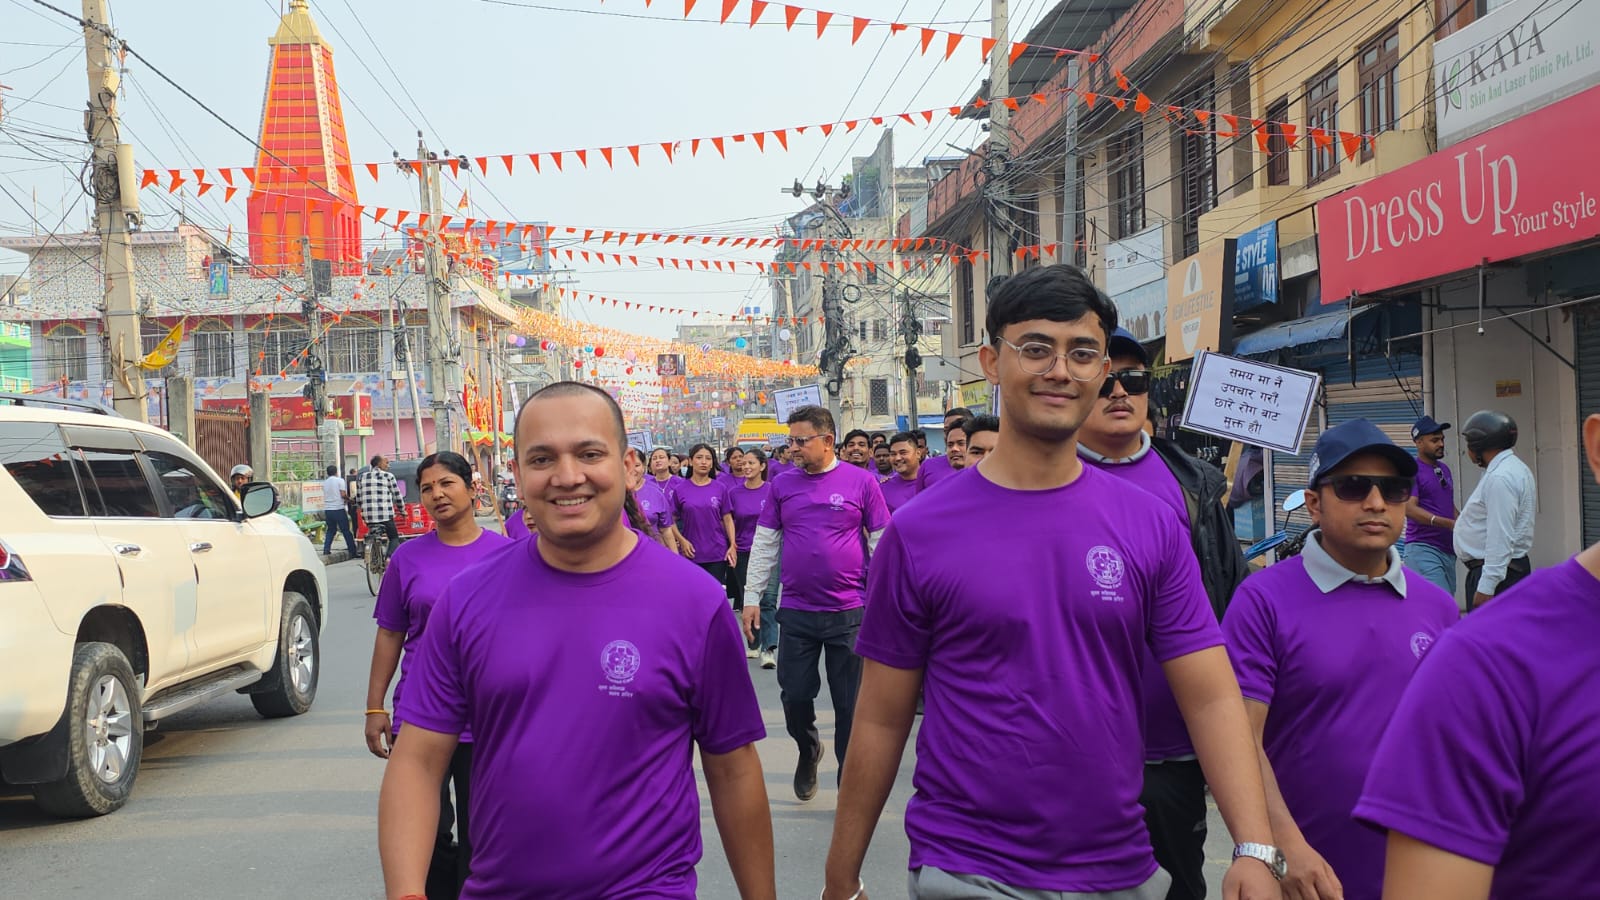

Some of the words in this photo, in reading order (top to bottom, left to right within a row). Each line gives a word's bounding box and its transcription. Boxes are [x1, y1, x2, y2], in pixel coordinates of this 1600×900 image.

[1469, 17, 1545, 87] KAYA
[1470, 91, 1486, 110] Skin
[1488, 82, 1502, 100] And
[1504, 74, 1526, 93] Laser
[1529, 59, 1553, 84] Clinic
[1556, 51, 1573, 72] Pvt.
[1575, 40, 1594, 62] Ltd.
[1344, 180, 1445, 262] Dress
[1454, 144, 1519, 236] Up
[1510, 210, 1549, 238] Your
[1552, 191, 1598, 229] Style
[1241, 239, 1267, 271] STYLE
[1220, 382, 1256, 400] उपचार
[1229, 368, 1255, 381] समय
[1258, 374, 1271, 385] मा
[1214, 397, 1235, 411] छारे
[1239, 402, 1257, 416] रोग
[1261, 408, 1281, 422] बाट
[1223, 416, 1246, 430] मुक्त
